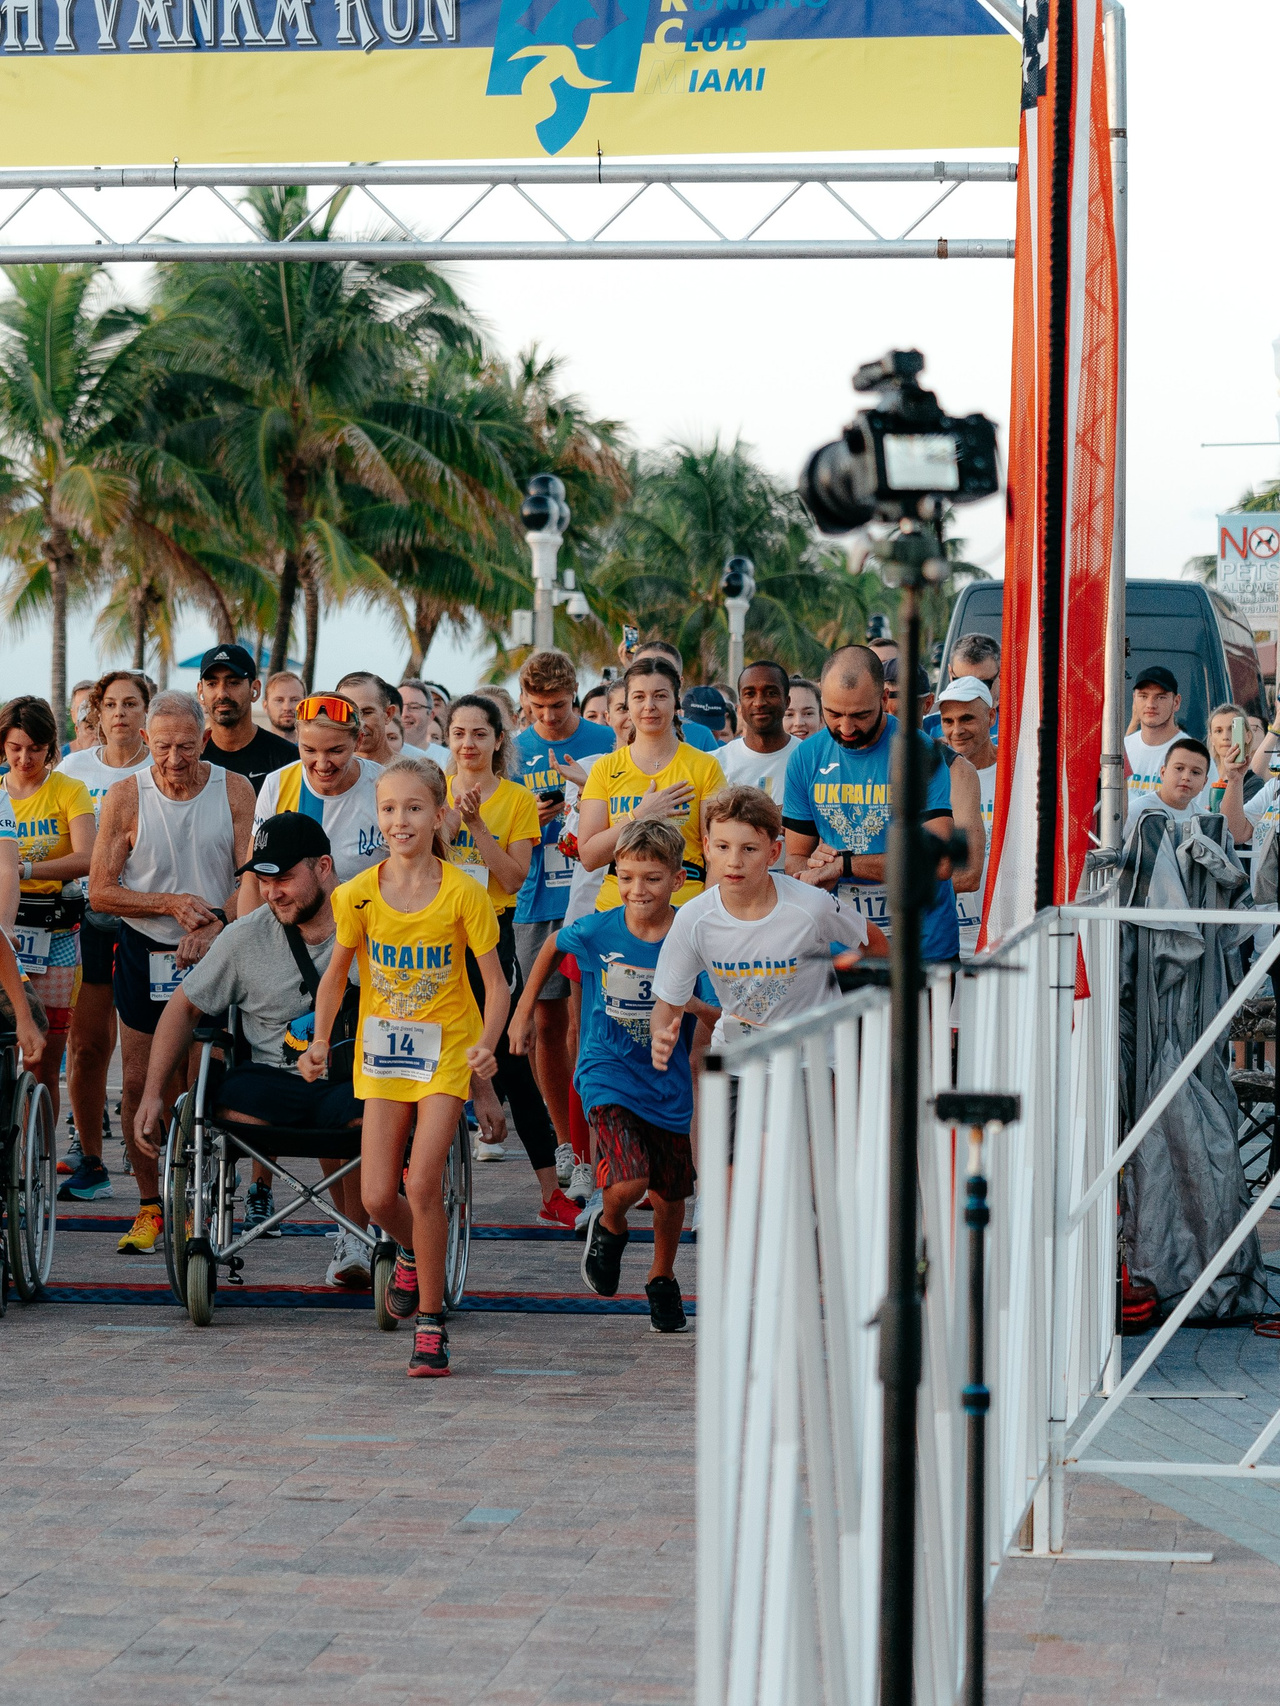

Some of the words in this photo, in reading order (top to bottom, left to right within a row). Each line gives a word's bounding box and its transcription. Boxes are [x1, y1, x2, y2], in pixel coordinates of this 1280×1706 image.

[654, 18, 748, 53] CLUB
[644, 60, 765, 94] MIAMI
[1221, 562, 1279, 581] PETS
[17, 817, 59, 838] AINE
[853, 896, 887, 916] 117
[712, 956, 797, 977] UKRAINE
[638, 980, 652, 1000] 3
[387, 1033, 414, 1055] 14
[363, 1065, 374, 1073] Photo
